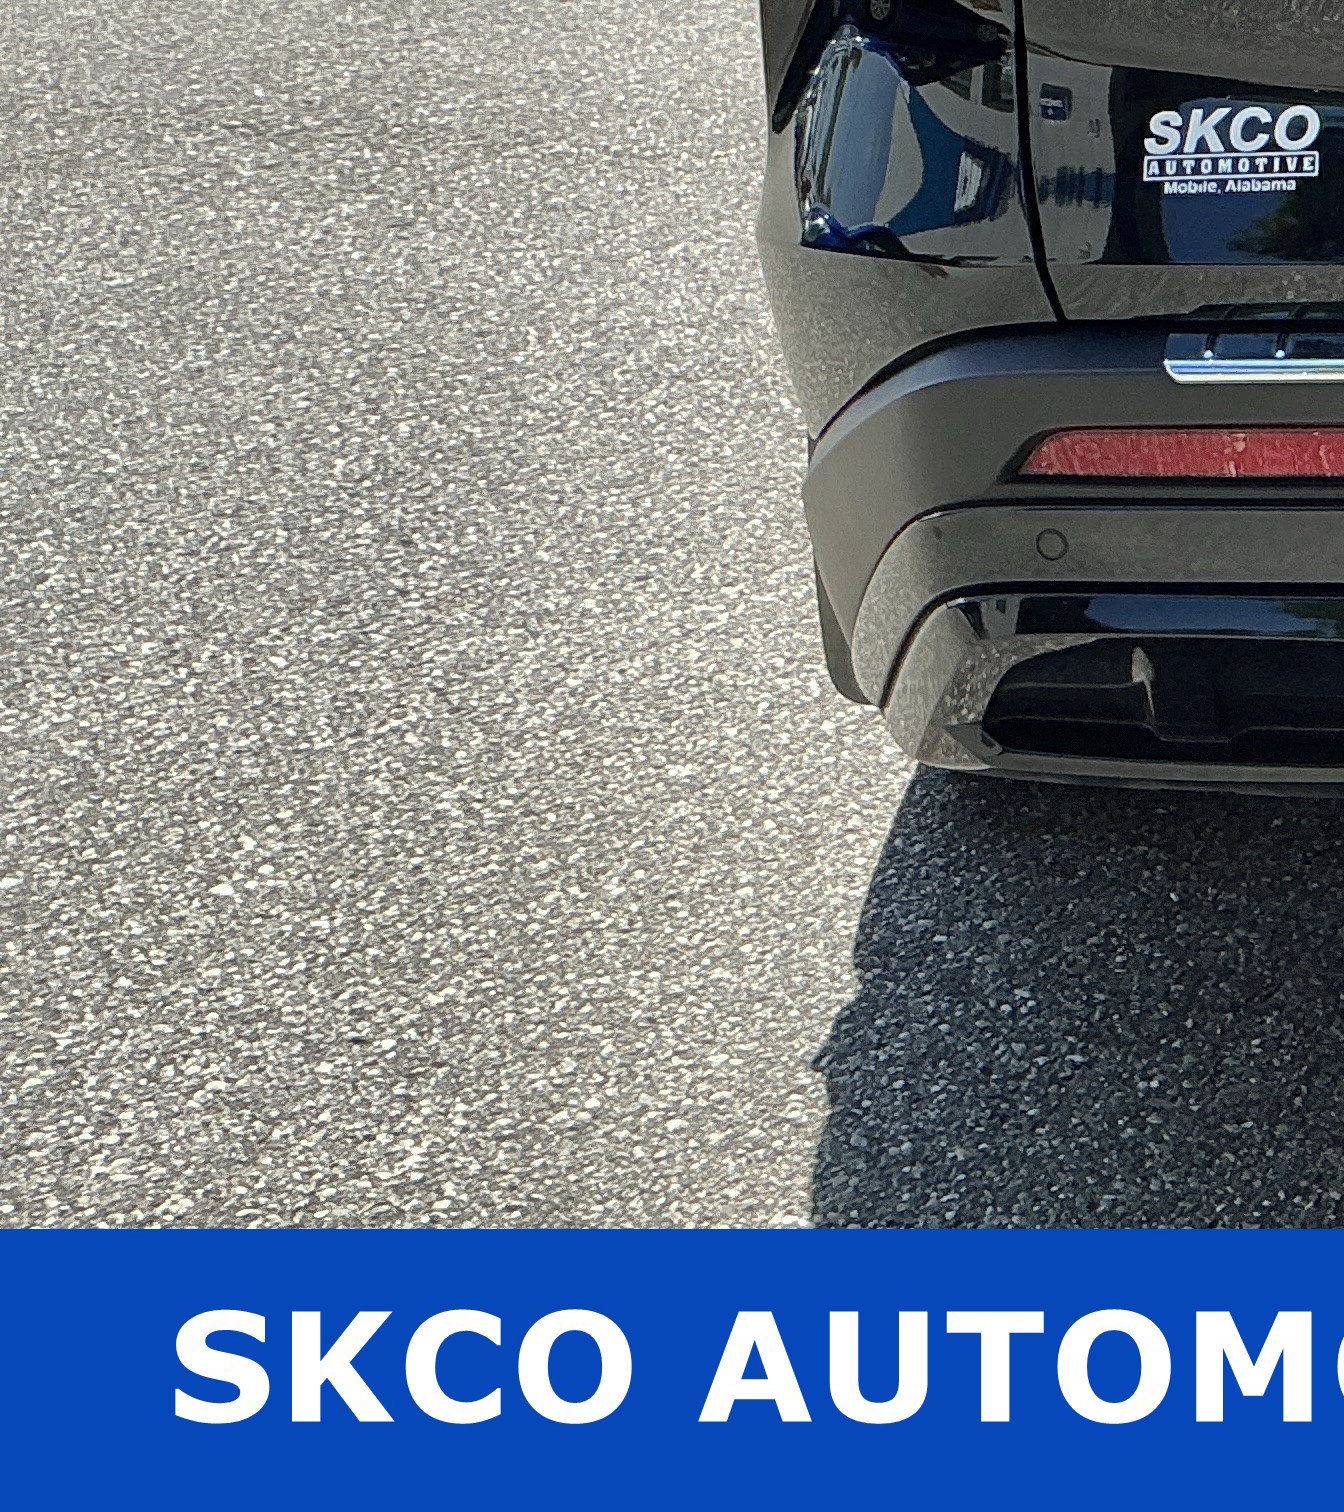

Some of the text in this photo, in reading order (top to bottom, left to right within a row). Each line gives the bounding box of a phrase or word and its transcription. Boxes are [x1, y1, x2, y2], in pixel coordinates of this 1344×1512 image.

[1143, 104, 1322, 156] SKCO
[1147, 156, 1316, 176] AUTOMOTIVE
[1163, 179, 1297, 195] Mobile, Alabama
